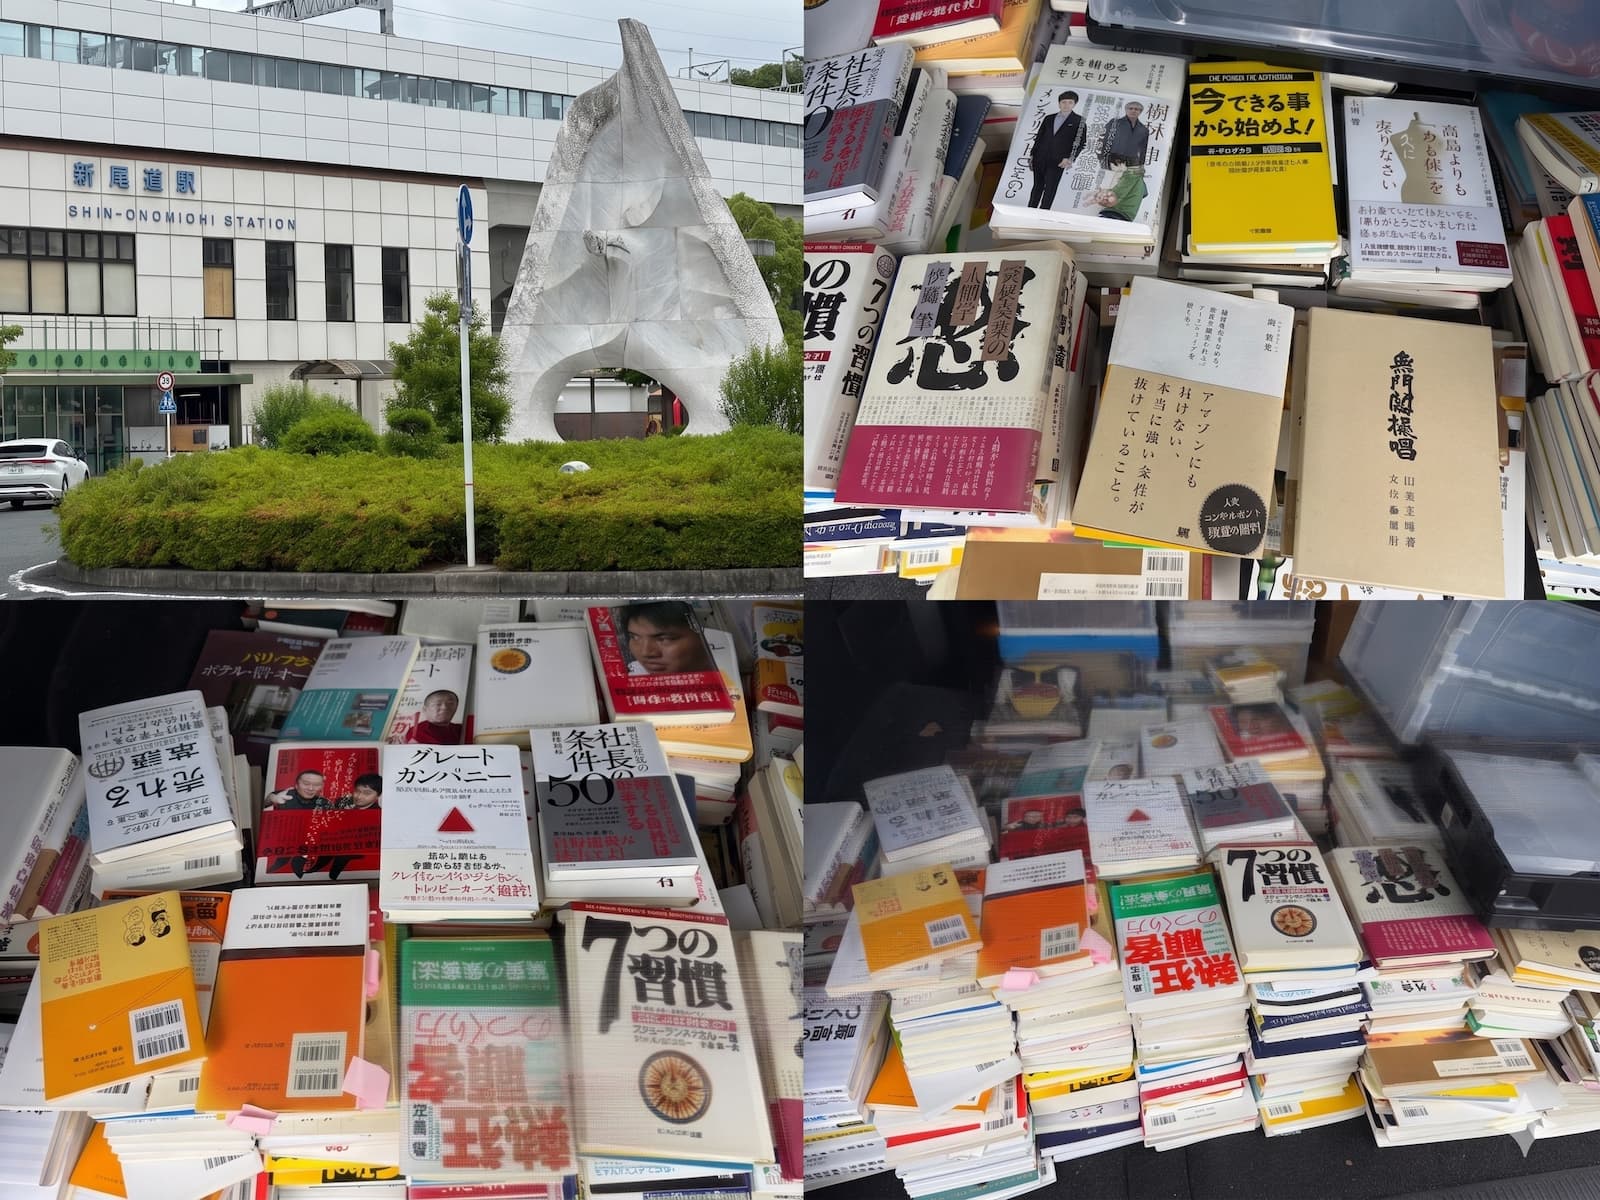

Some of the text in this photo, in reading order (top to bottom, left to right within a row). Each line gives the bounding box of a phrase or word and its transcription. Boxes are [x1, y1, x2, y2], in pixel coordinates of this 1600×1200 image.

[1192, 87, 1311, 115] 今できる事
[73, 161, 195, 194] 新尾道駅
[224, 215, 296, 231] STATION
[1111, 376, 1149, 503] 抜けていること。
[410, 748, 495, 766] グレート
[564, 729, 602, 773] 条件
[104, 766, 204, 809] 売れる
[547, 772, 615, 807] 50
[1123, 928, 1207, 965] 顧客
[1148, 953, 1240, 995] 熱狂
